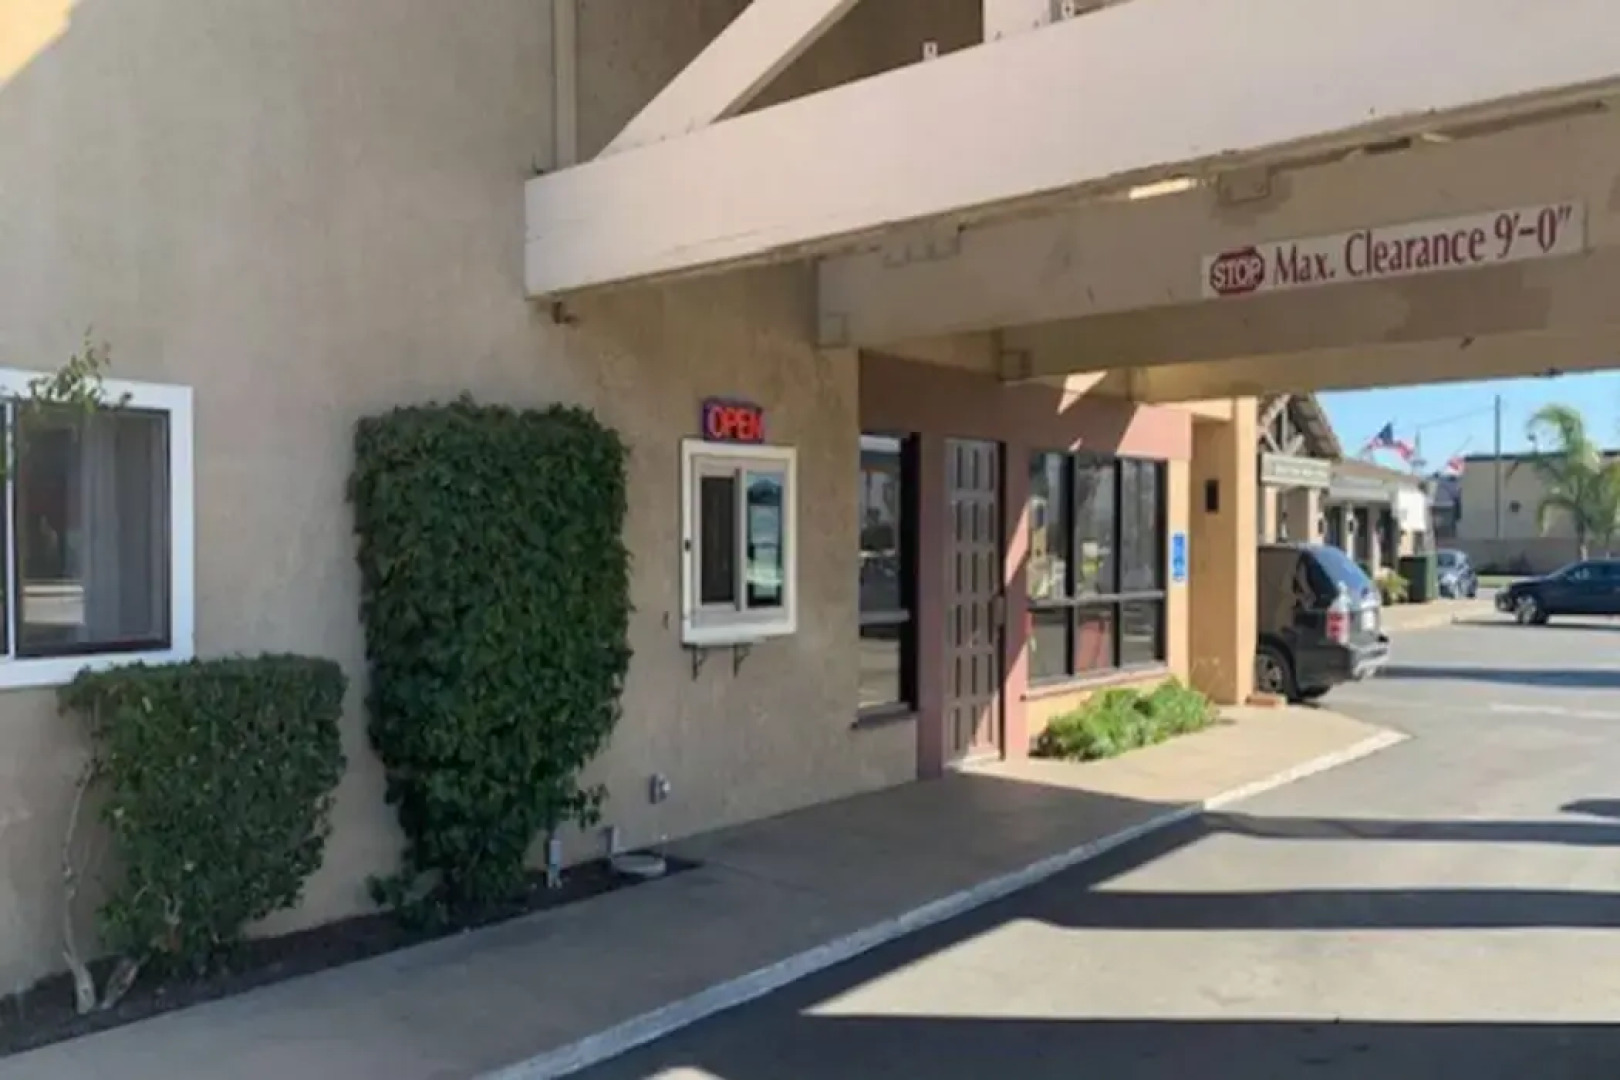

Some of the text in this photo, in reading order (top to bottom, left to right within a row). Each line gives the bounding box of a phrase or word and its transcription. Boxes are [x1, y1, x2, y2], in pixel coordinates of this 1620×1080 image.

[1212, 257, 1263, 288] STOP
[1274, 243, 1335, 284] Max.
[1345, 228, 1485, 277] Clearance
[707, 405, 764, 440] OPEN
